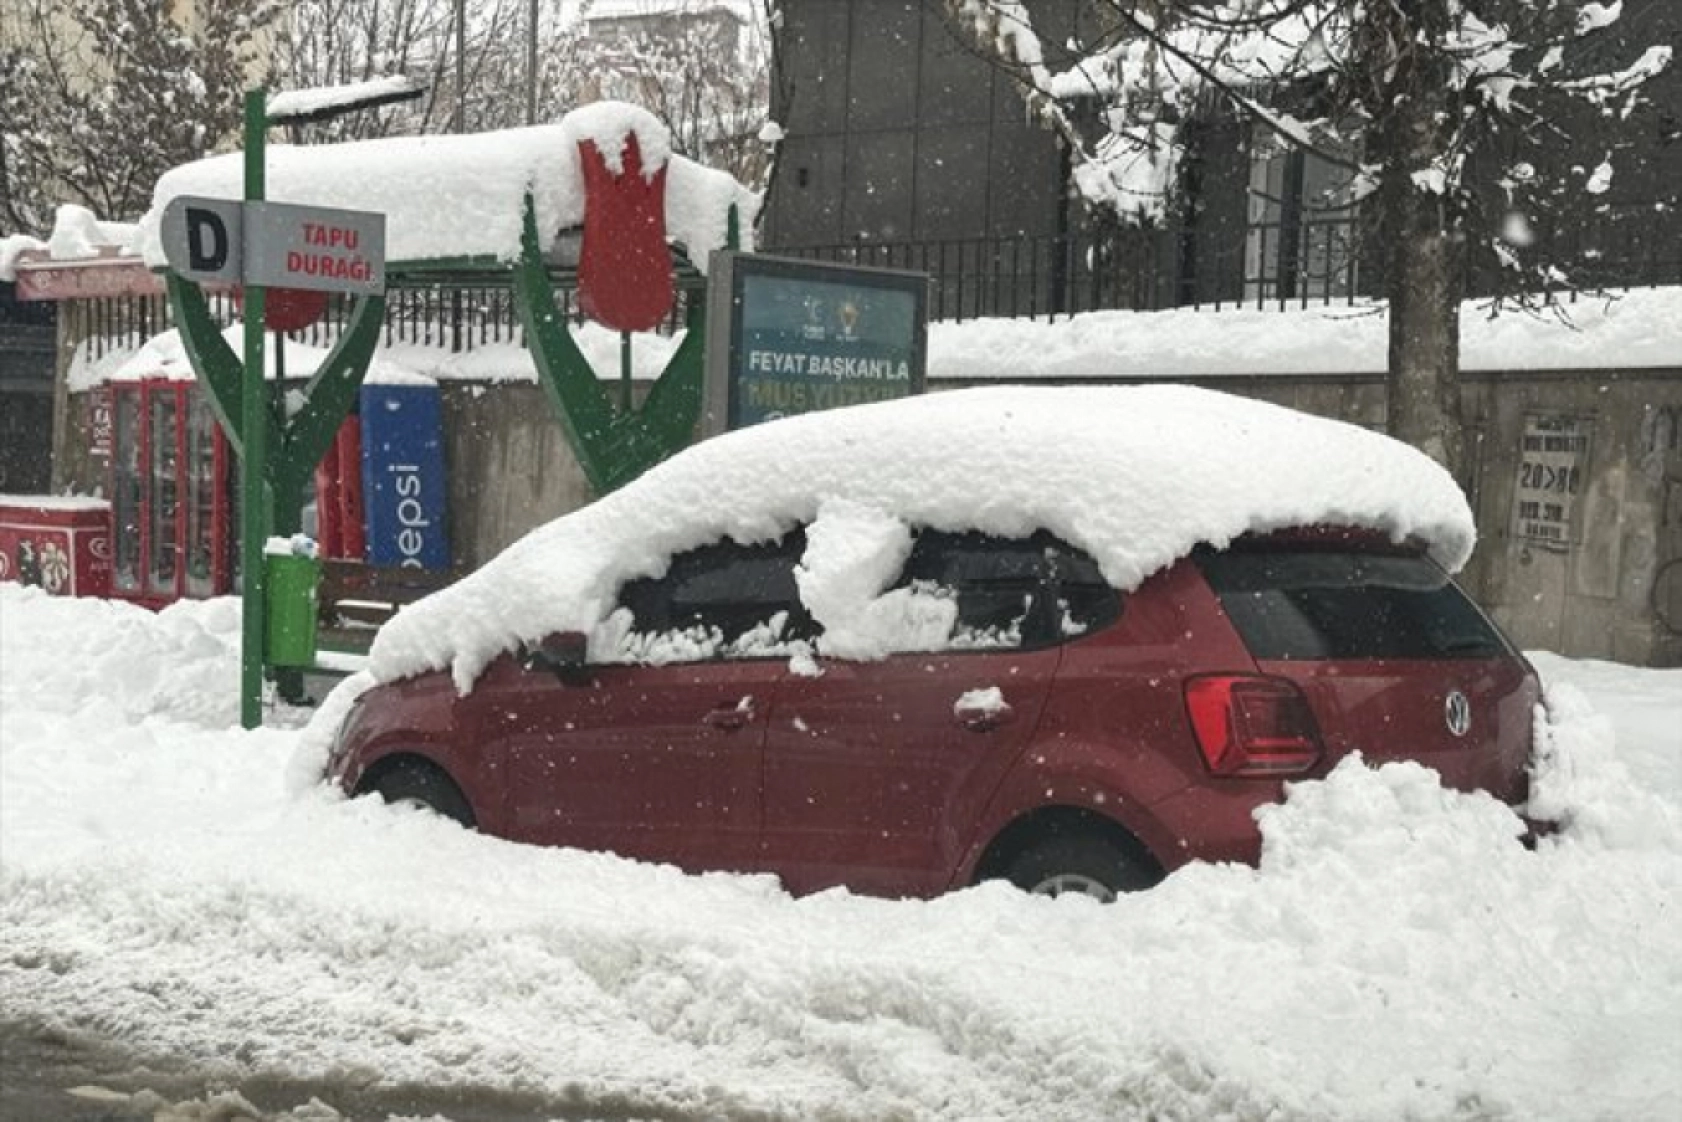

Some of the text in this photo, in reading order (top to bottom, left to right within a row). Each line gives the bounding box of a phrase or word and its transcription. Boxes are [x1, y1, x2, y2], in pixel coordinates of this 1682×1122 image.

[186, 207, 229, 272] D
[303, 223, 359, 250] TAPU
[287, 251, 371, 282] DURAĞI
[750, 352, 806, 375] FEYAT
